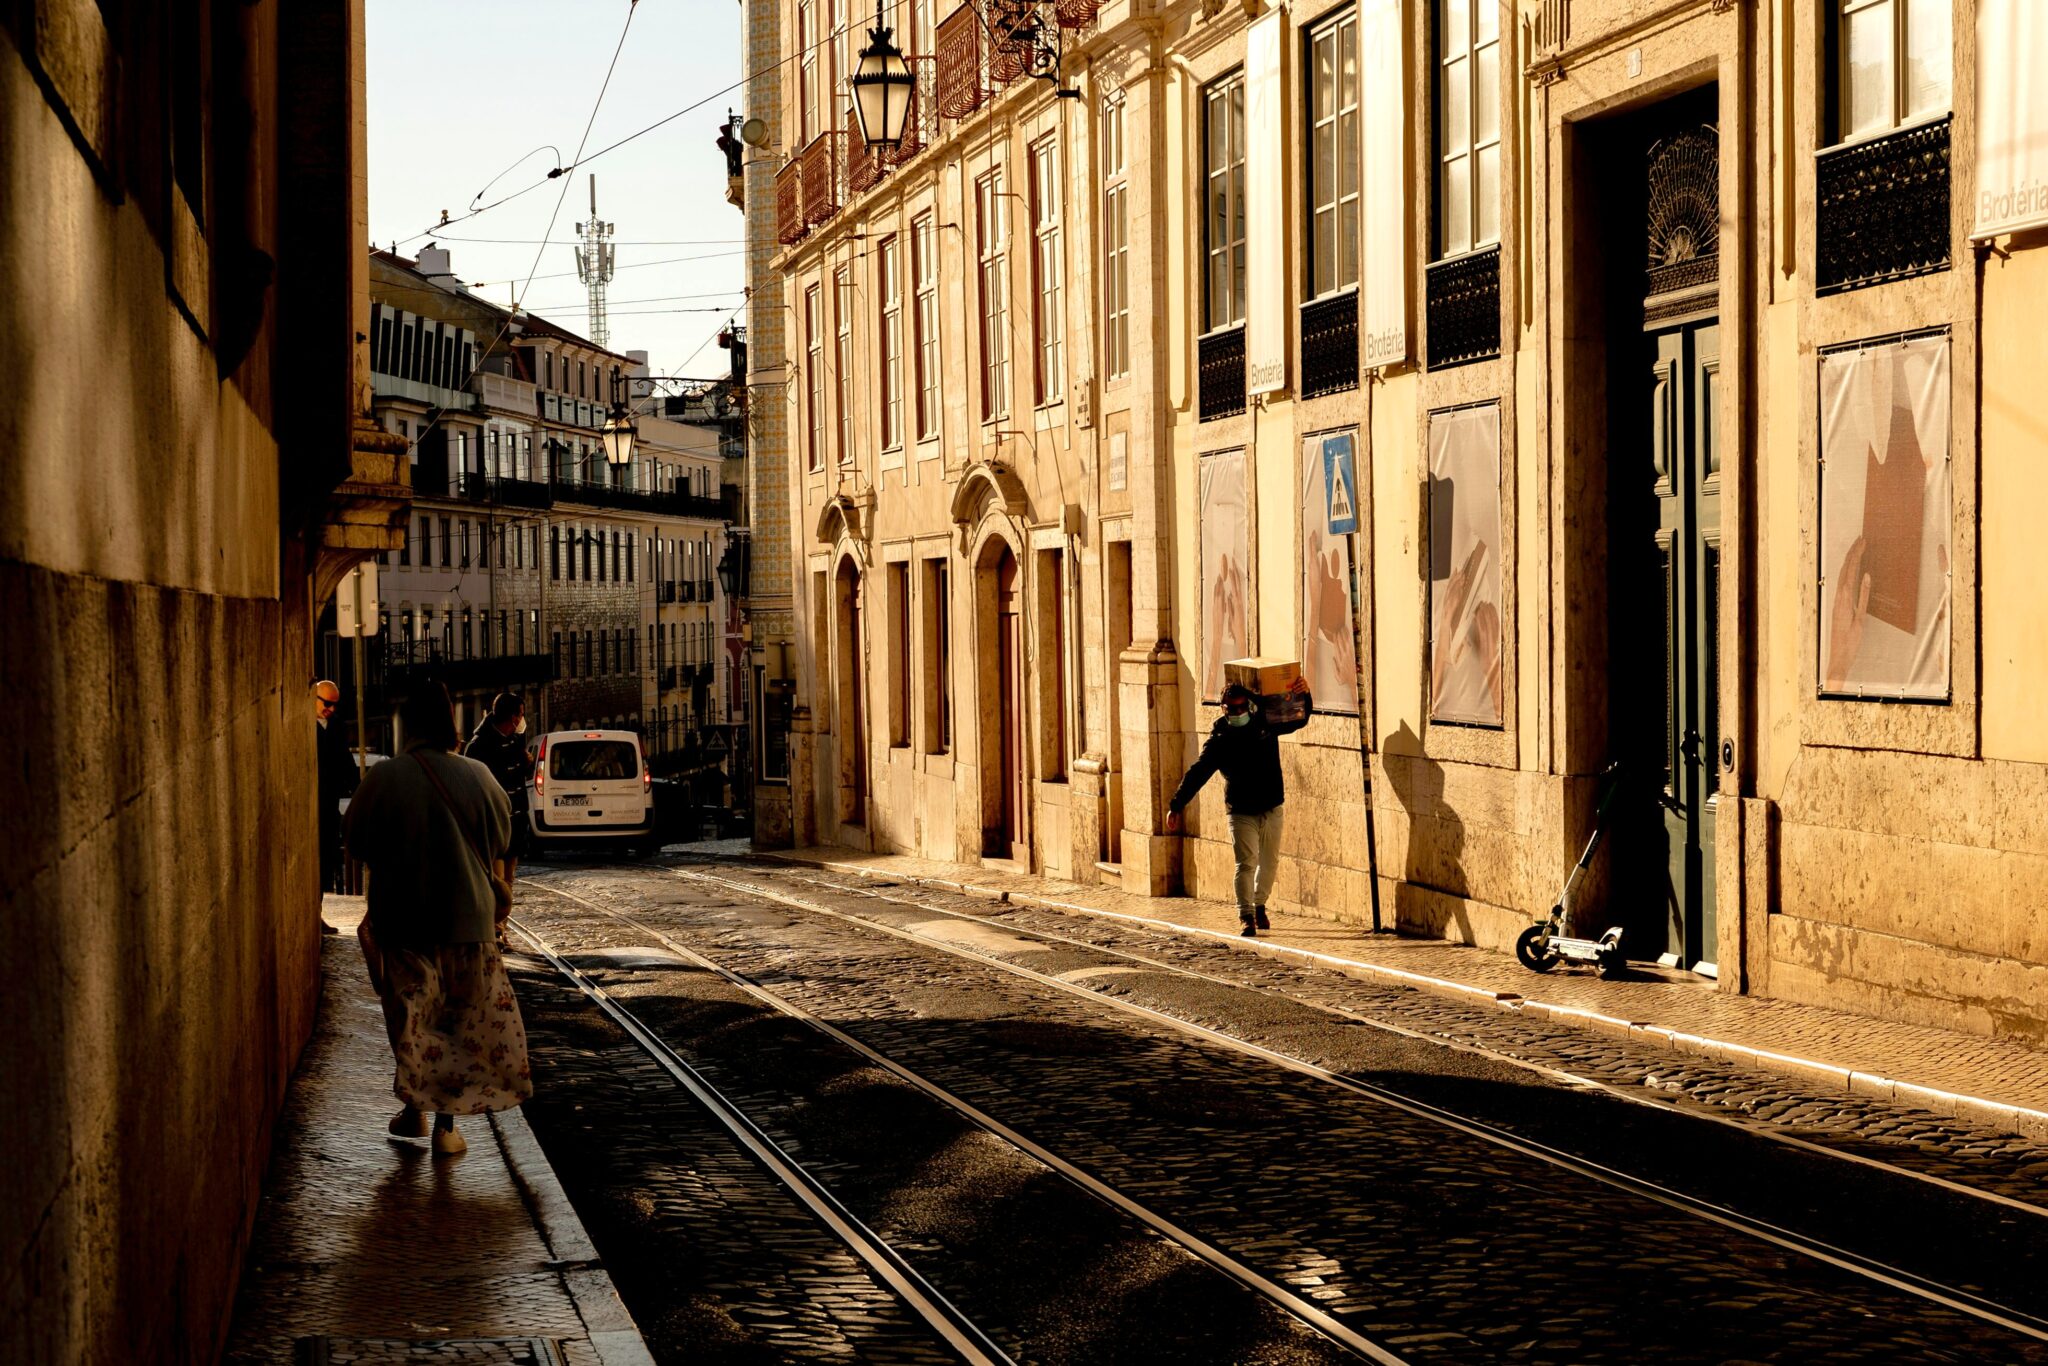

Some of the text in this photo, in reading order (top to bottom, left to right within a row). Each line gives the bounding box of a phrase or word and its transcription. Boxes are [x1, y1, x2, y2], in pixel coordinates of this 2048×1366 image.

[1980, 178, 2048, 223] Brotéria
[1367, 327, 1404, 359] Brotéria
[1251, 358, 1283, 387] Brotéria
